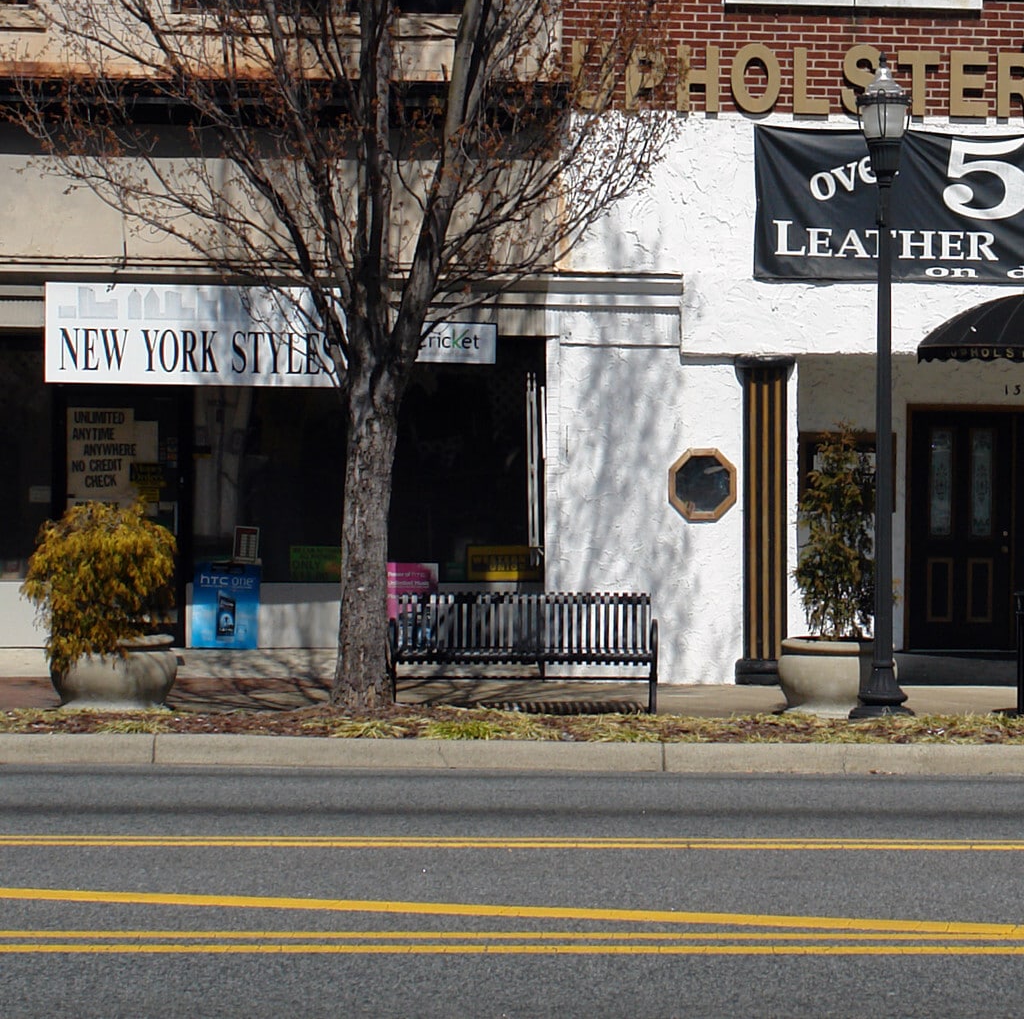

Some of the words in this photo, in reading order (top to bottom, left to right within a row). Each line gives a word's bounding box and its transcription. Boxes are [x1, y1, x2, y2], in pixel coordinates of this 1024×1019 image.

[809, 154, 900, 201] ove
[924, 265, 979, 278] on
[59, 327, 129, 371] NEW
[141, 330, 219, 374] YORK
[231, 331, 337, 376] STYLES
[73, 411, 125, 425] UNLIMITED
[72, 427, 115, 441] ANYTIME
[83, 443, 137, 457] ANYWHERE
[72, 460, 86, 473] NO
[89, 458, 122, 472] CREDIT
[85, 475, 118, 488] CHECK
